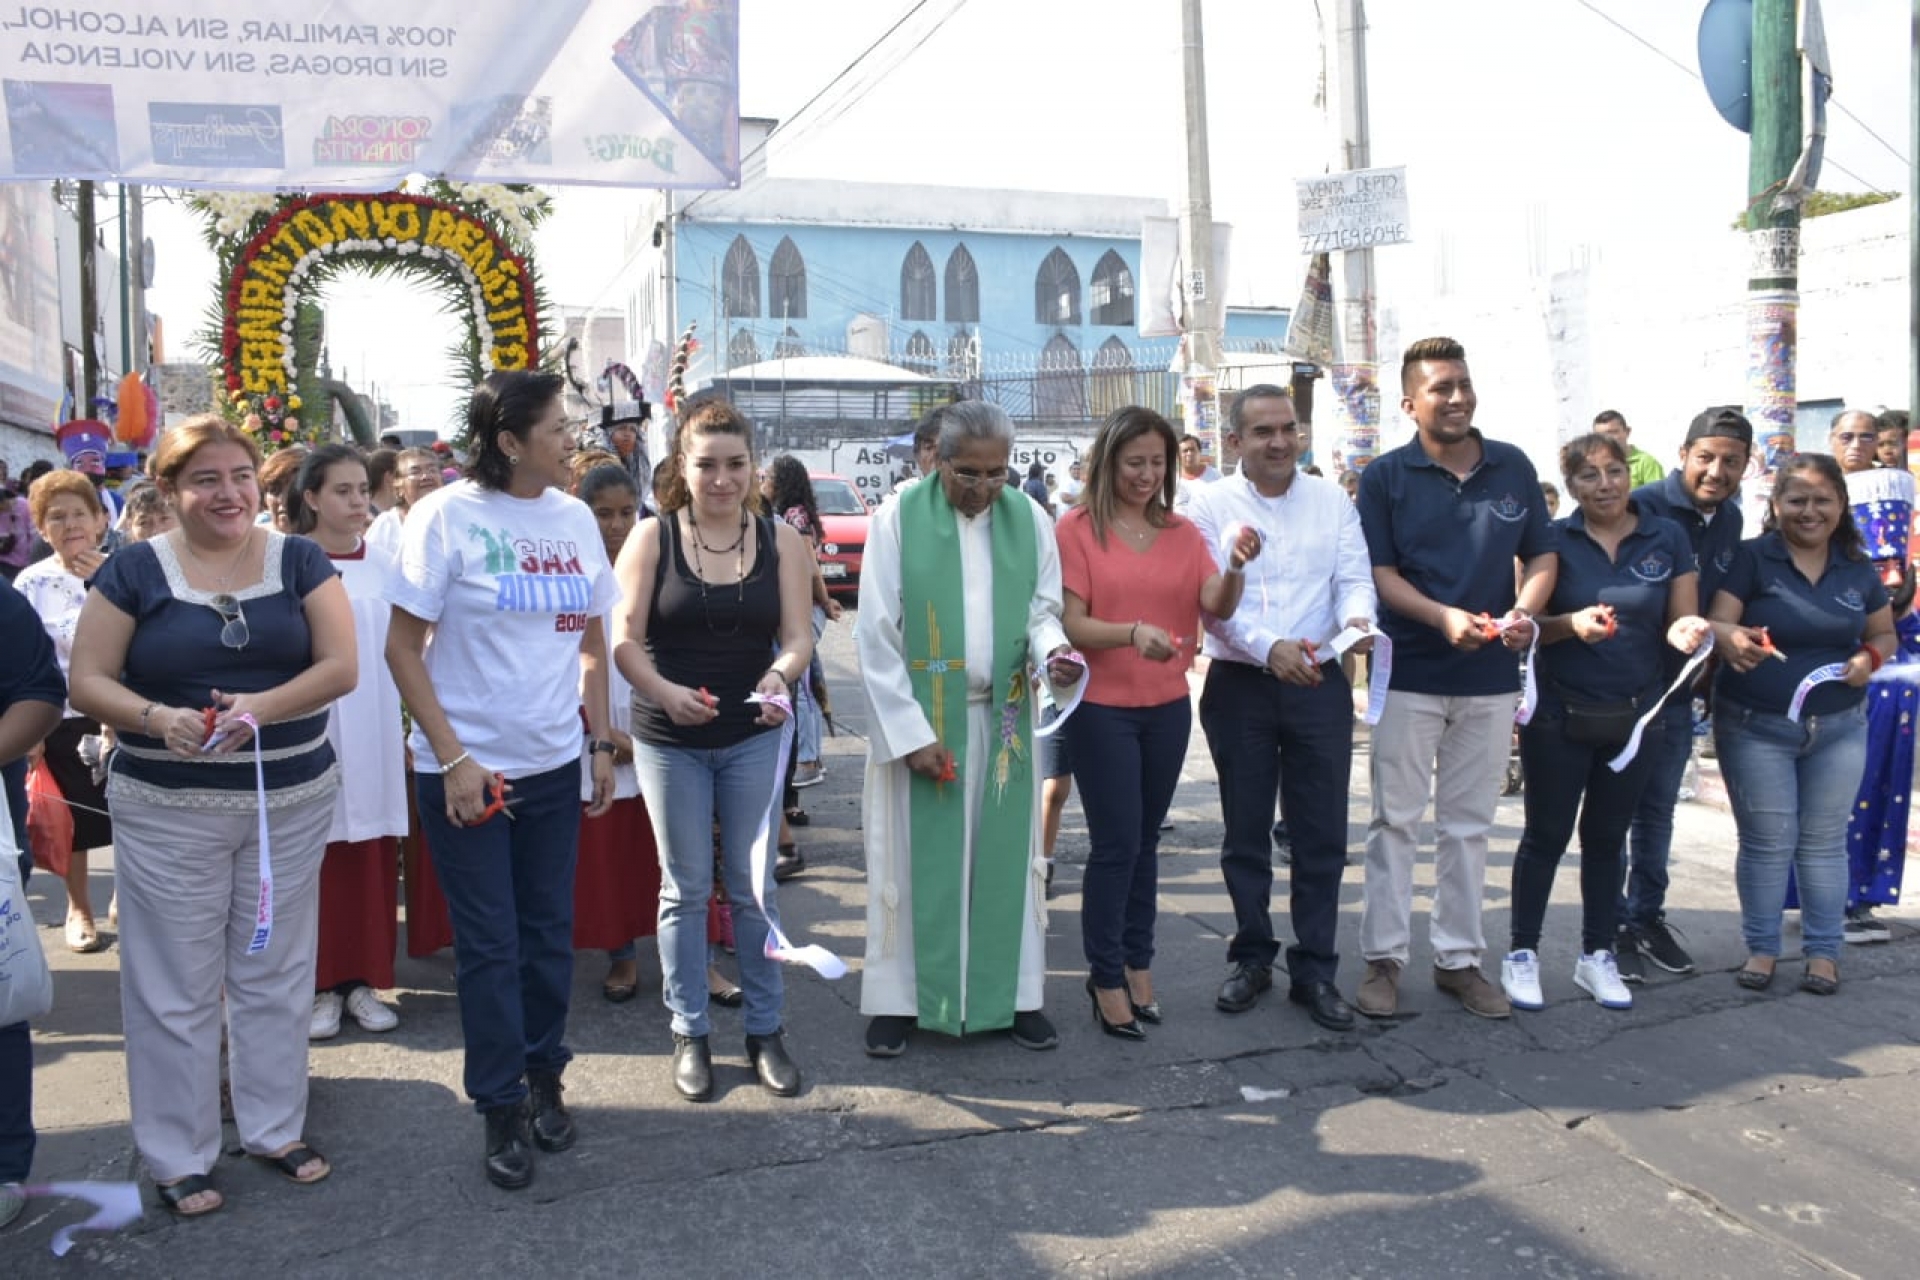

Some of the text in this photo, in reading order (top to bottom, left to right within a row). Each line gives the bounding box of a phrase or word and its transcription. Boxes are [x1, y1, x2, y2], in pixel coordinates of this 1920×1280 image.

[1307, 180, 1345, 197] VENTA
[1013, 448, 1057, 464] isto
[513, 538, 585, 575] SAN
